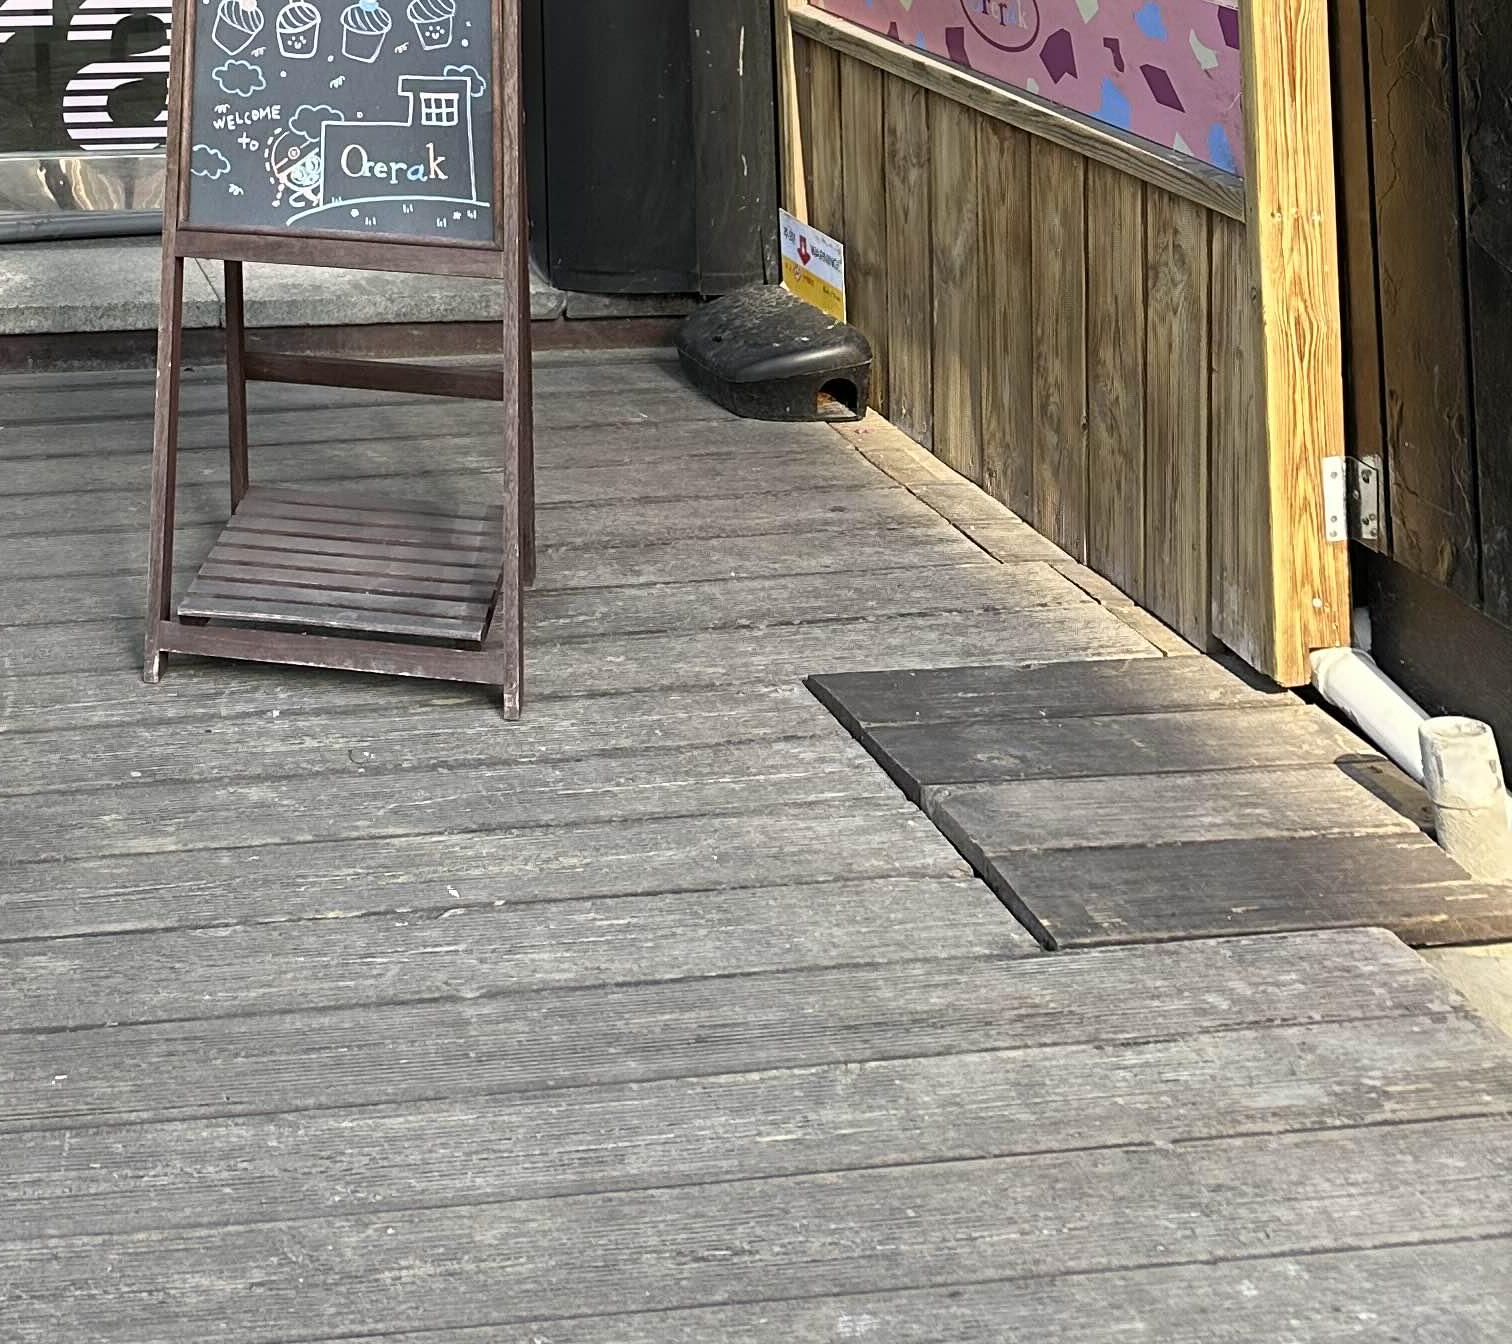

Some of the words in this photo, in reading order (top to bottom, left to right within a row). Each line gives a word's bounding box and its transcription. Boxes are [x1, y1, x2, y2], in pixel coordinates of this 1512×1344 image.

[213, 104, 281, 130] WELCOME
[237, 131, 260, 152] to
[340, 142, 448, 185] Orerak
